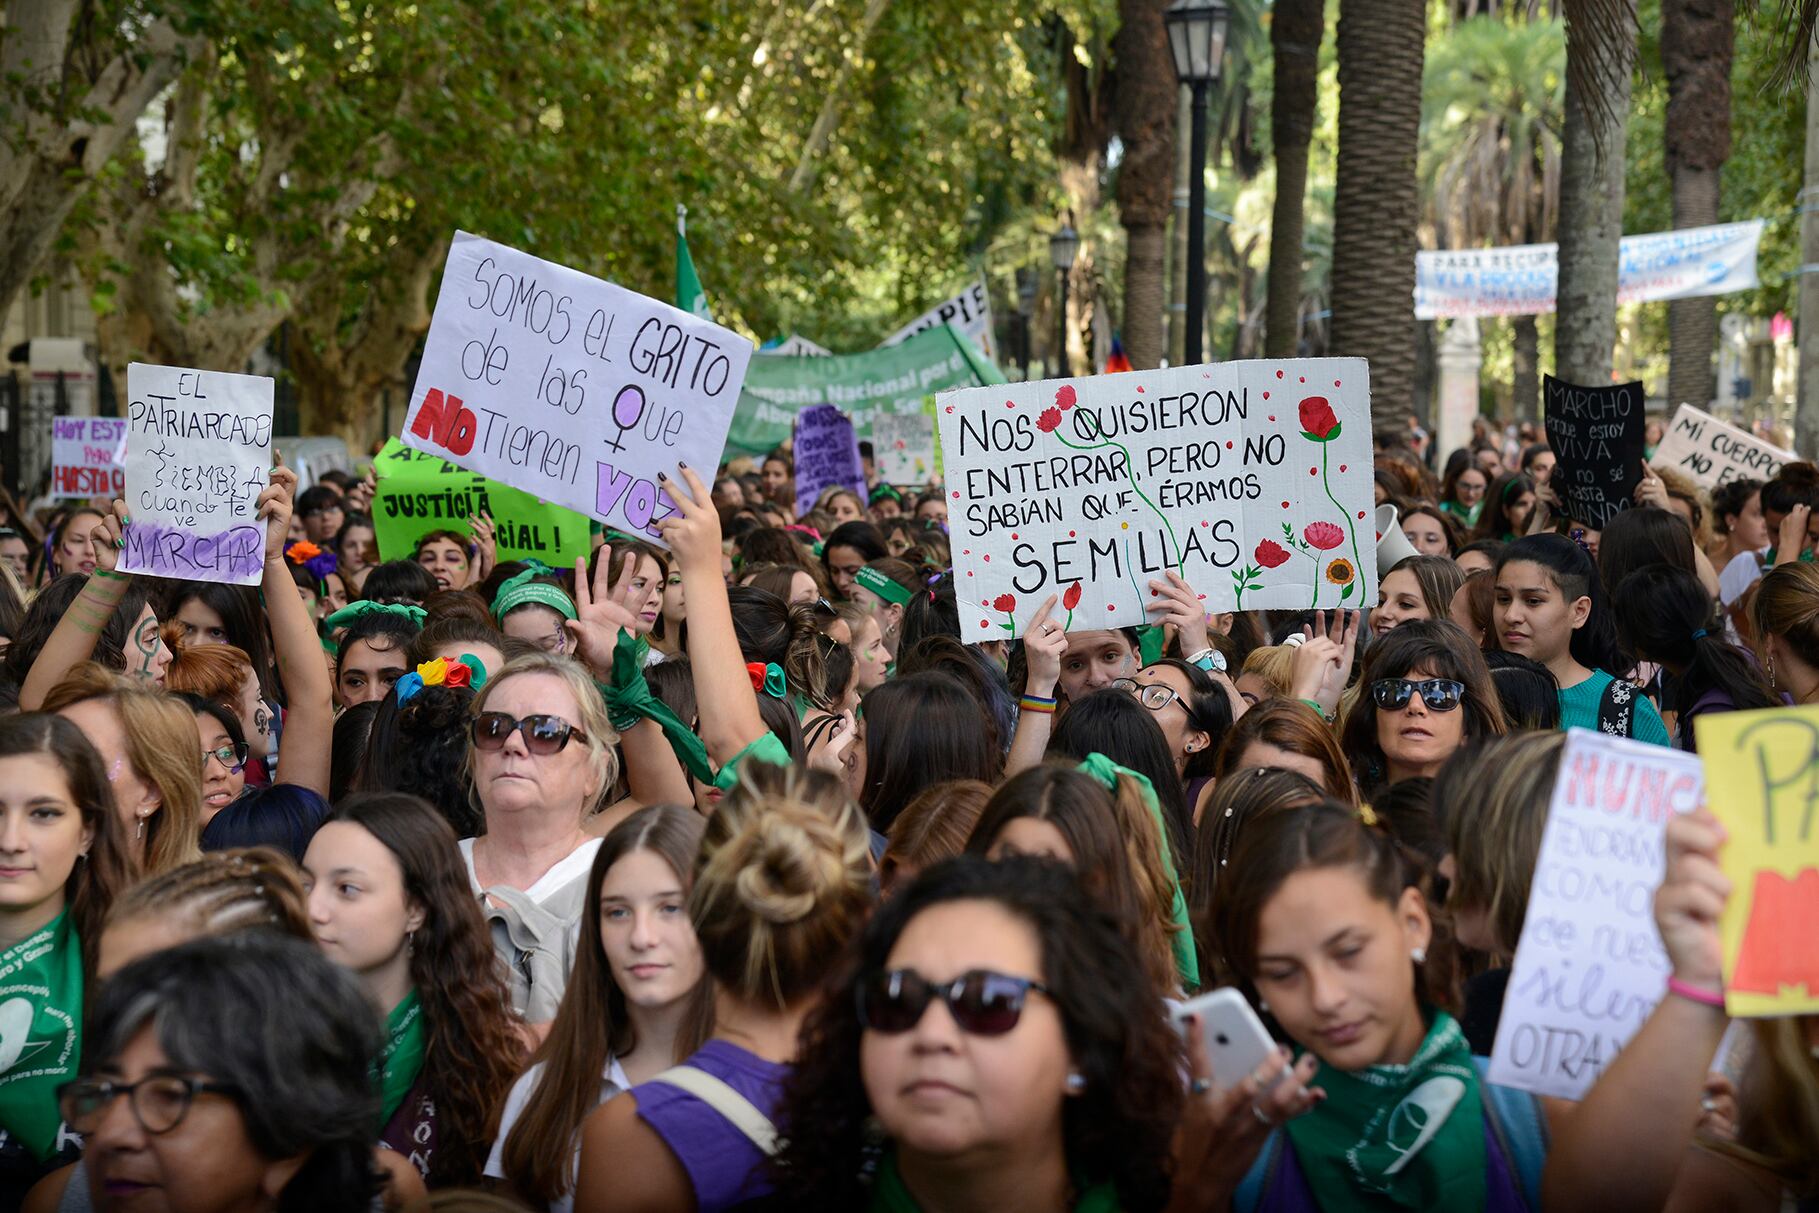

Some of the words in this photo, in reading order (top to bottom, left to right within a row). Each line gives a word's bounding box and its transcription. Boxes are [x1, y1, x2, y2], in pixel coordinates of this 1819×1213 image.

[468, 257, 573, 344] SOMOS
[629, 317, 730, 397] GRITO
[178, 373, 206, 399] EL
[461, 328, 509, 386] de
[537, 354, 587, 415] las
[751, 386, 821, 402] mpaña
[827, 369, 917, 401] Nacional
[920, 360, 947, 388] por
[129, 394, 272, 447] PATRIARCADO
[755, 403, 797, 424] Abo
[959, 409, 1035, 456] NOS
[1073, 387, 1248, 442] QUISIERON
[1548, 382, 1631, 420] MARCHO
[54, 419, 85, 441] HOY
[92, 420, 125, 441] EST
[410, 387, 477, 456] NO
[480, 407, 581, 485] Tienen
[1556, 435, 1612, 461] VIVA
[966, 448, 1142, 501] ENTERRAR,
[1147, 440, 1221, 477] PERO
[1243, 433, 1286, 466] NO
[1554, 467, 1564, 479] o
[1576, 469, 1595, 484] no
[1609, 464, 1624, 482] sé
[1680, 450, 1713, 475] NO
[1711, 433, 1784, 478] CUERPO
[54, 465, 109, 494] HASTA
[175, 515, 197, 526] ve
[966, 497, 1064, 537] SABÍAN
[1082, 490, 1139, 521] QUE
[1159, 474, 1262, 509] ÉRAMOS
[125, 526, 264, 576] MARCHAR
[492, 520, 560, 553] CIAL!
[1012, 519, 1241, 595] SEMILLAS
[1566, 751, 1698, 824] NUNC
[14, 931, 55, 953] Derech
[1592, 923, 1667, 971] nues
[1516, 956, 1655, 1022] silen
[1509, 1022, 1604, 1081] OTRA
